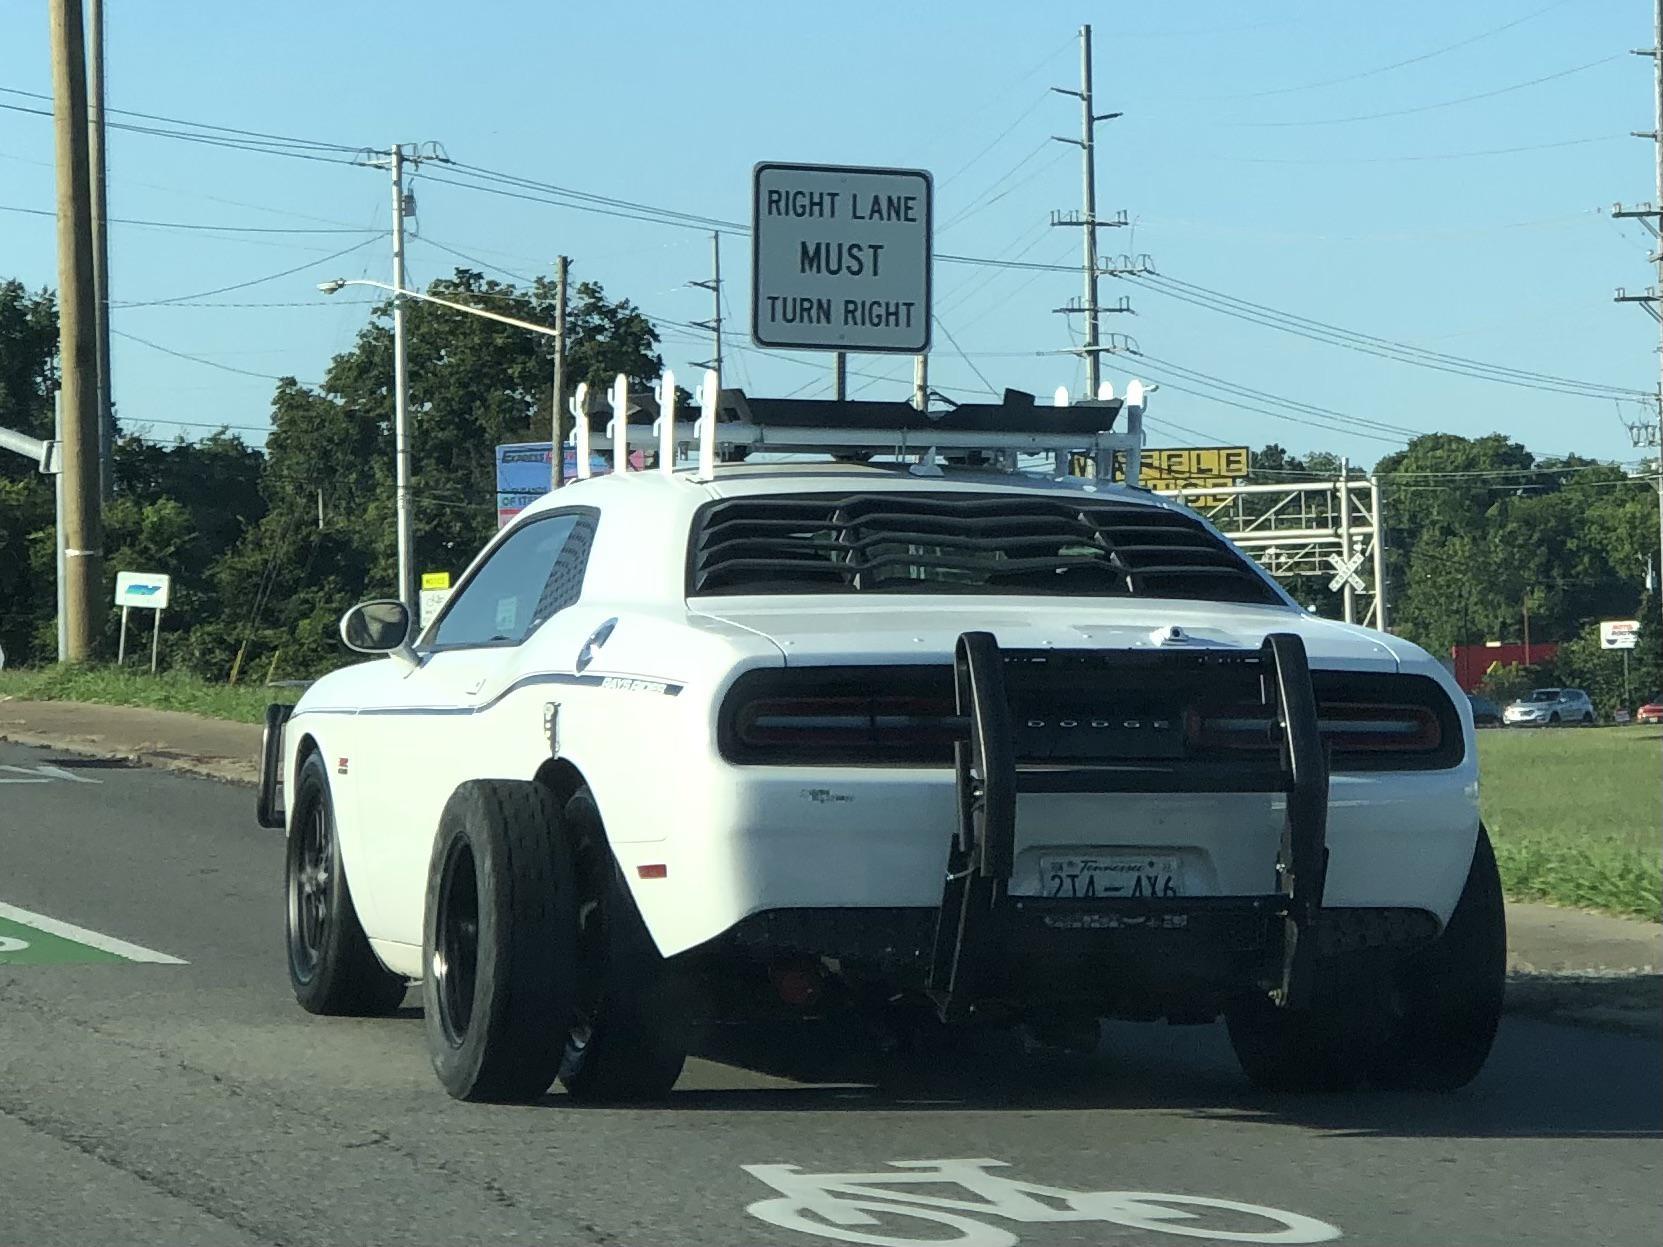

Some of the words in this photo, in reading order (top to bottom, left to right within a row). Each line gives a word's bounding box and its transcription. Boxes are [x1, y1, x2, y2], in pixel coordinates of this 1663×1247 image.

[767, 189, 840, 219] RIGHT
[851, 193, 918, 223] LANE
[799, 241, 885, 277] MUST
[767, 295, 832, 325] TURN
[843, 299, 915, 328] RIGHT
